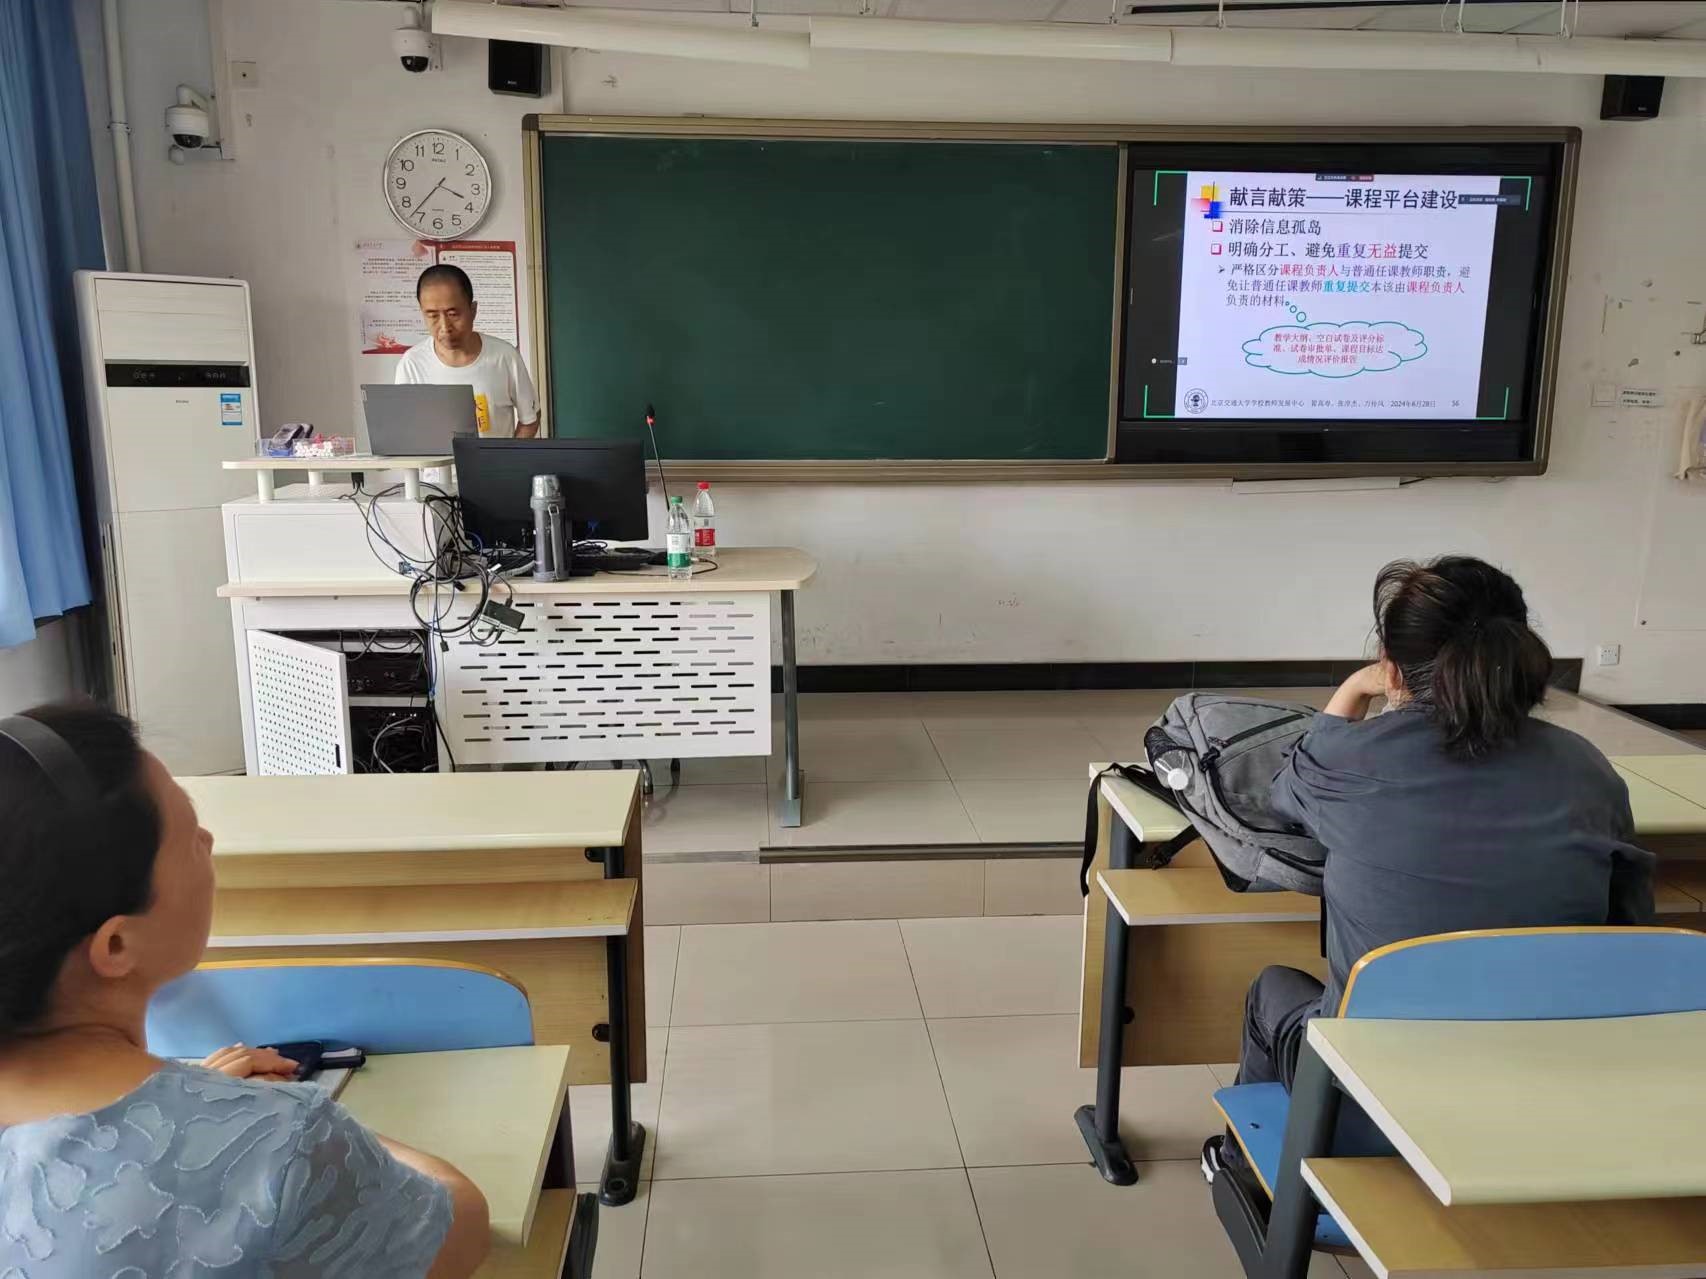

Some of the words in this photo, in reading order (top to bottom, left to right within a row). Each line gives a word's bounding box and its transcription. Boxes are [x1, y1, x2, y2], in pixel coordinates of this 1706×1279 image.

[415, 144, 425, 157] 11
[432, 142, 445, 155] 12
[455, 148, 459, 161] 1
[400, 159, 415, 171] 10
[465, 164, 475, 176] 2
[395, 177, 407, 190] 9
[471, 183, 481, 196] 3
[401, 196, 412, 208] 8
[1229, 186, 1458, 210] 献言献策——课程平台建设
[464, 202, 474, 213] 4
[416, 211, 426, 223] 7
[432, 217, 444, 230] 6
[451, 214, 462, 226] 5
[1228, 218, 1322, 236] 消除信息孤岛
[1228, 241, 1429, 260] 明确分工、避免重复无益提交
[1226, 279, 1465, 295] 免让普通任课教师重复提交本该由课程负责人
